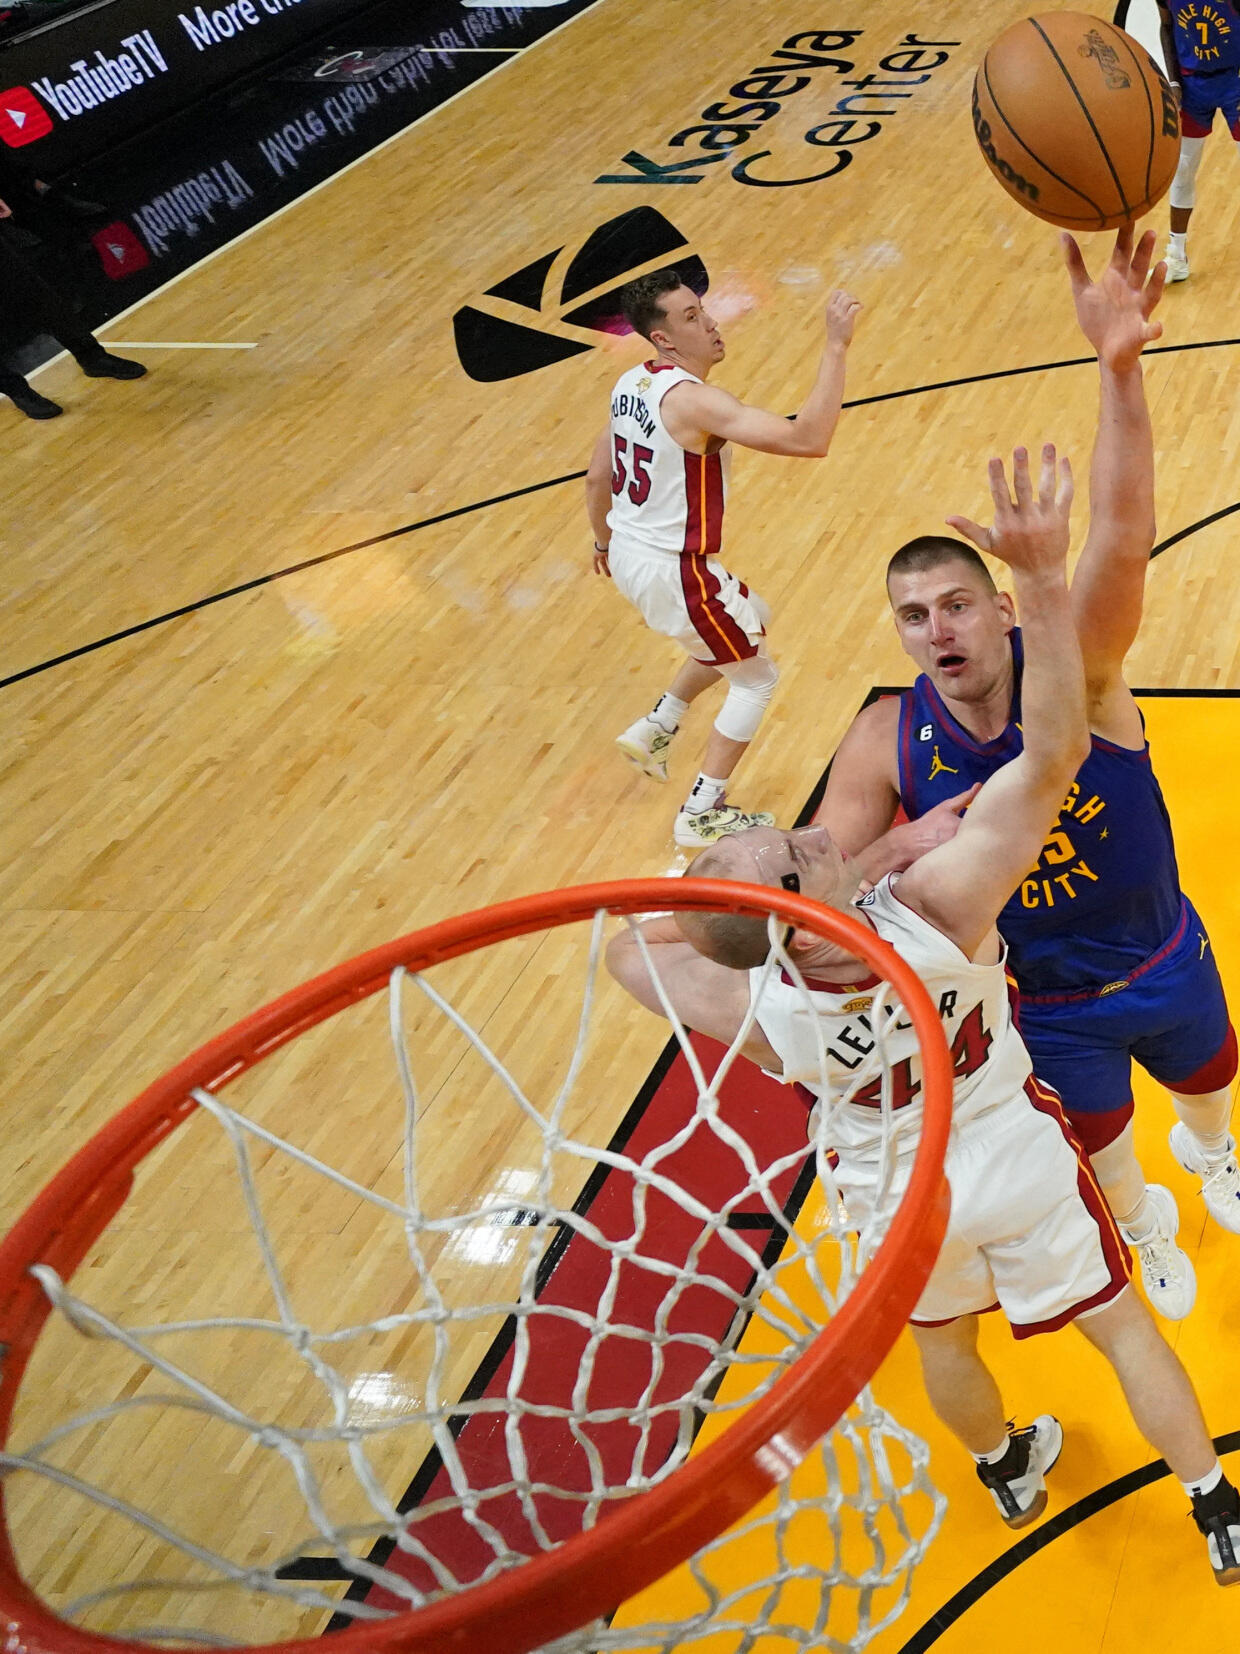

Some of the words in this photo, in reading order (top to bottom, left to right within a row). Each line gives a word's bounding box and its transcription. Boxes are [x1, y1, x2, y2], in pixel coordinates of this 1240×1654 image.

[177, 0, 260, 51] More
[1195, 22, 1207, 45] 7
[1202, 4, 1231, 34] HIGH
[1194, 45, 1220, 60] CITY
[592, 30, 864, 184] Kaseya
[731, 34, 961, 187] Center
[612, 394, 656, 439] OBINSON
[611, 433, 654, 507] 55
[920, 724, 933, 741] 6
[1061, 781, 1106, 824] GH
[1021, 860, 1099, 909] CITY
[850, 999, 994, 1113] 44
